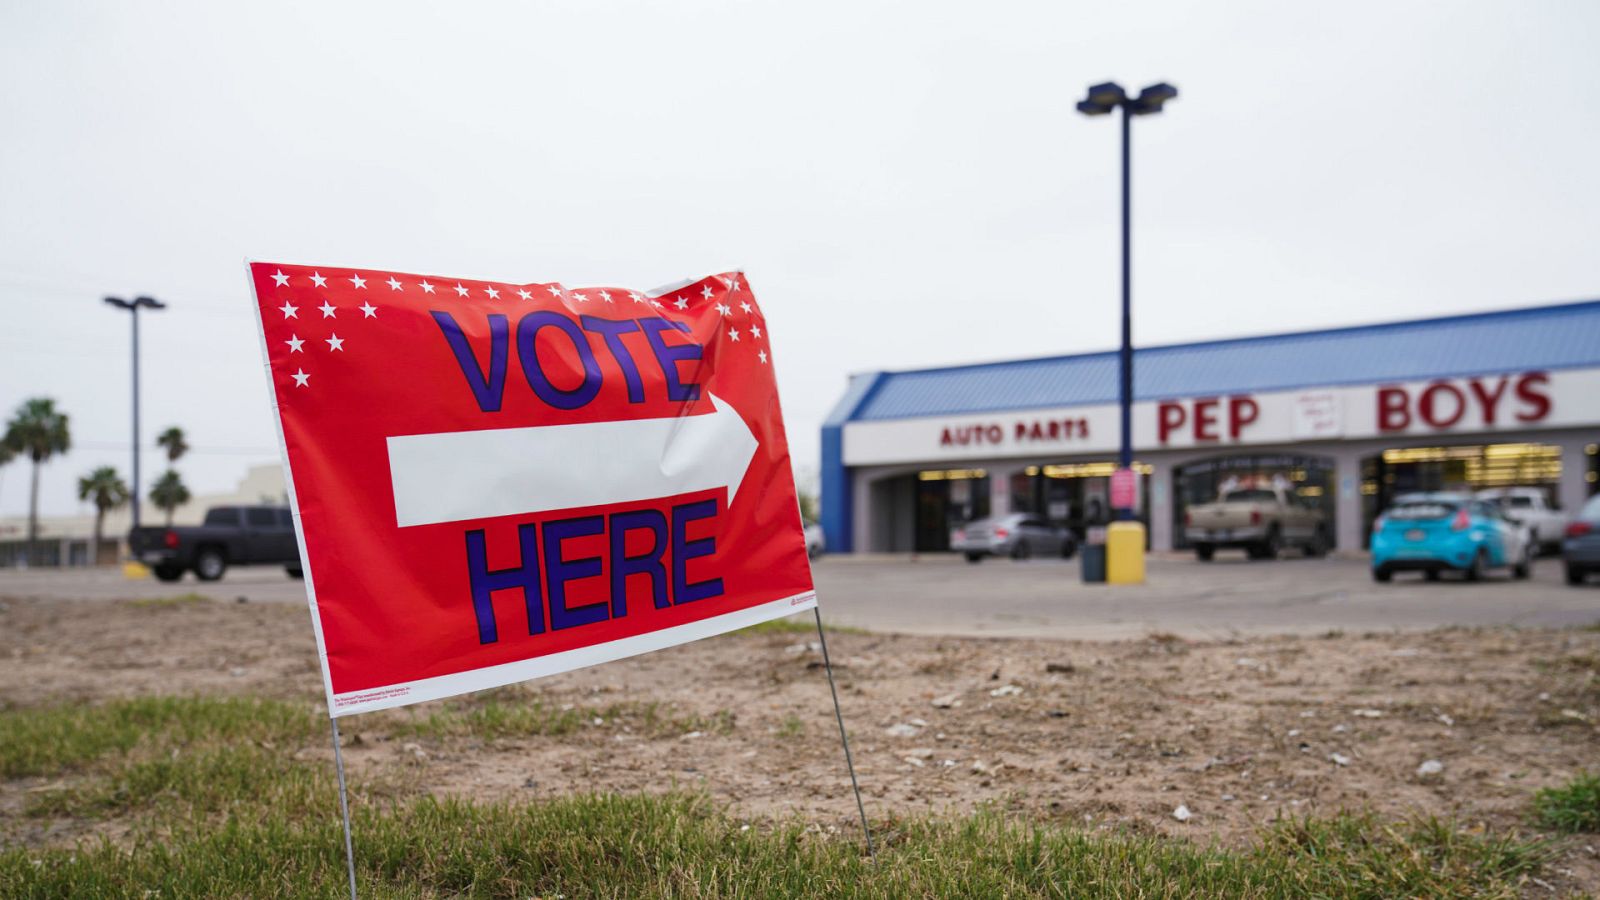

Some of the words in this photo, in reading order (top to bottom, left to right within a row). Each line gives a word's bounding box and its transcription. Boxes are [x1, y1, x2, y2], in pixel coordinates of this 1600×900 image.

[430, 310, 704, 413] VOTE
[940, 424, 1004, 446] AUTO
[1014, 417, 1090, 442] PARTS
[1156, 396, 1261, 445] PEP
[1376, 371, 1553, 433] BOYS
[464, 498, 725, 646] HERE
